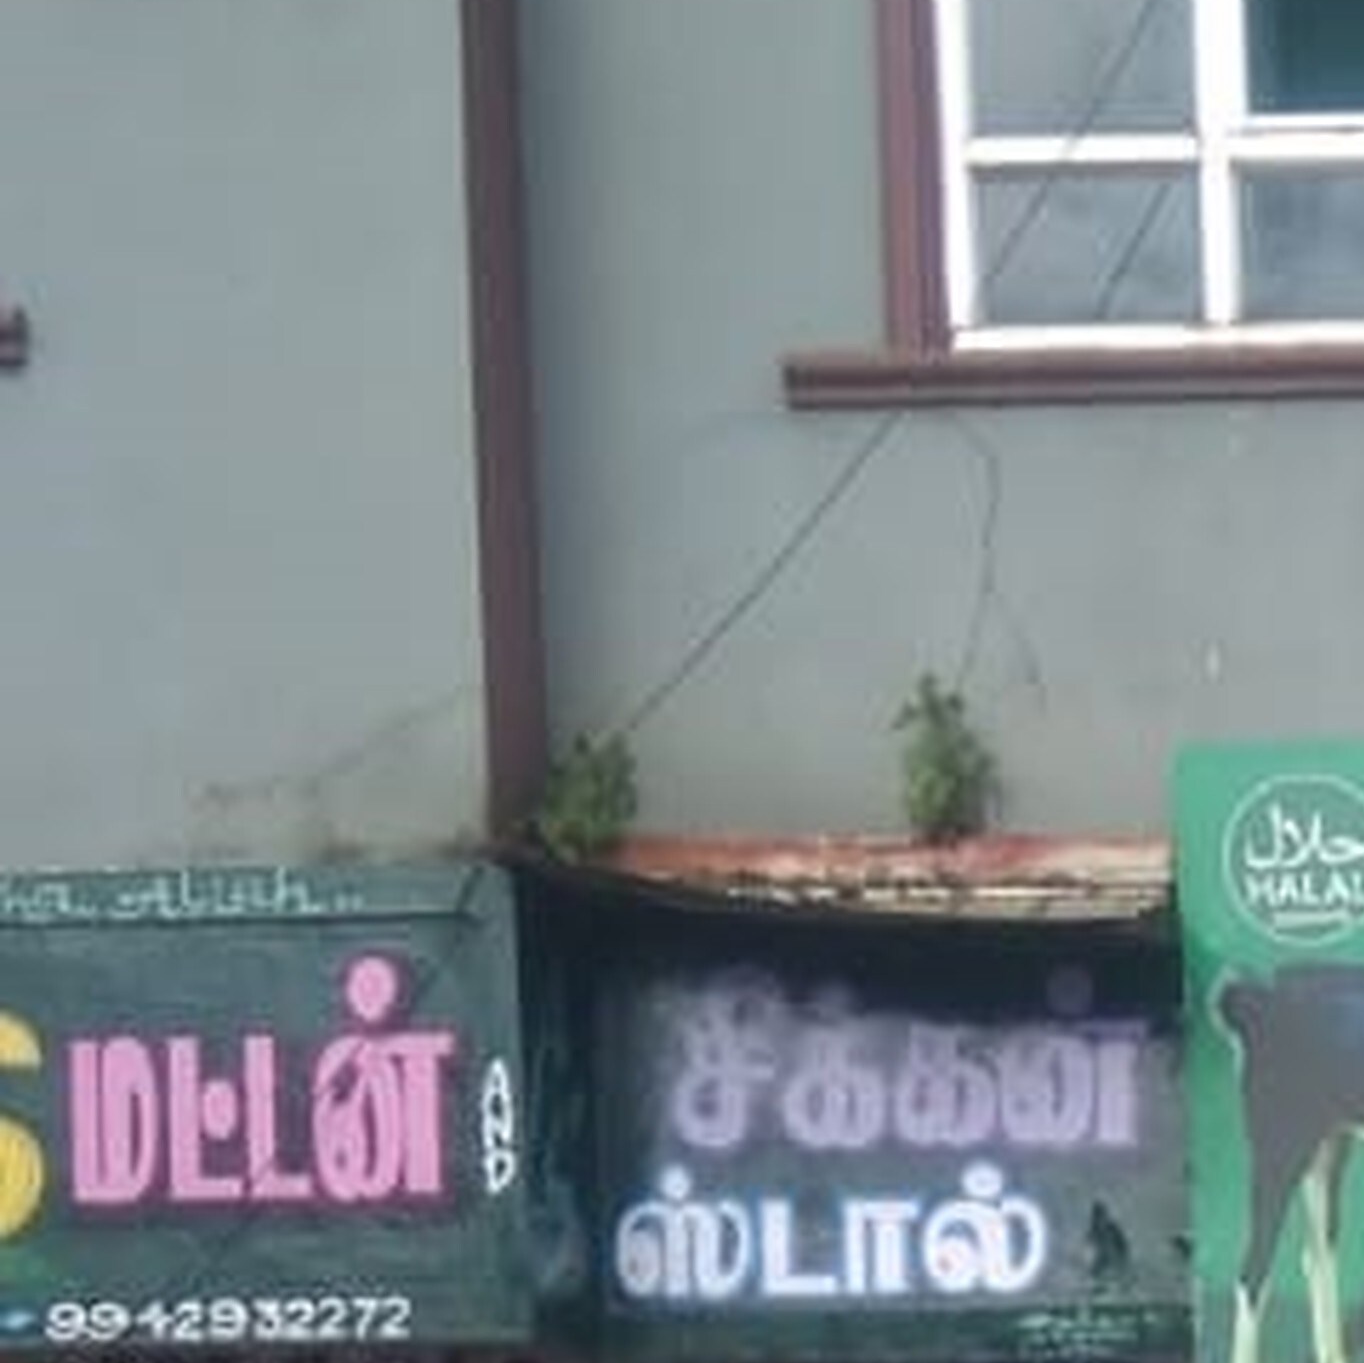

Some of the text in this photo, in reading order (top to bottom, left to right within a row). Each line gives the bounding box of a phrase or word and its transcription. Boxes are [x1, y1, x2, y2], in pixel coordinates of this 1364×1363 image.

[68, 954, 457, 1204] மட்டன்
[615, 1166, 1047, 1299] ஸ்டால்
[44, 1295, 413, 1342] 9942932272
